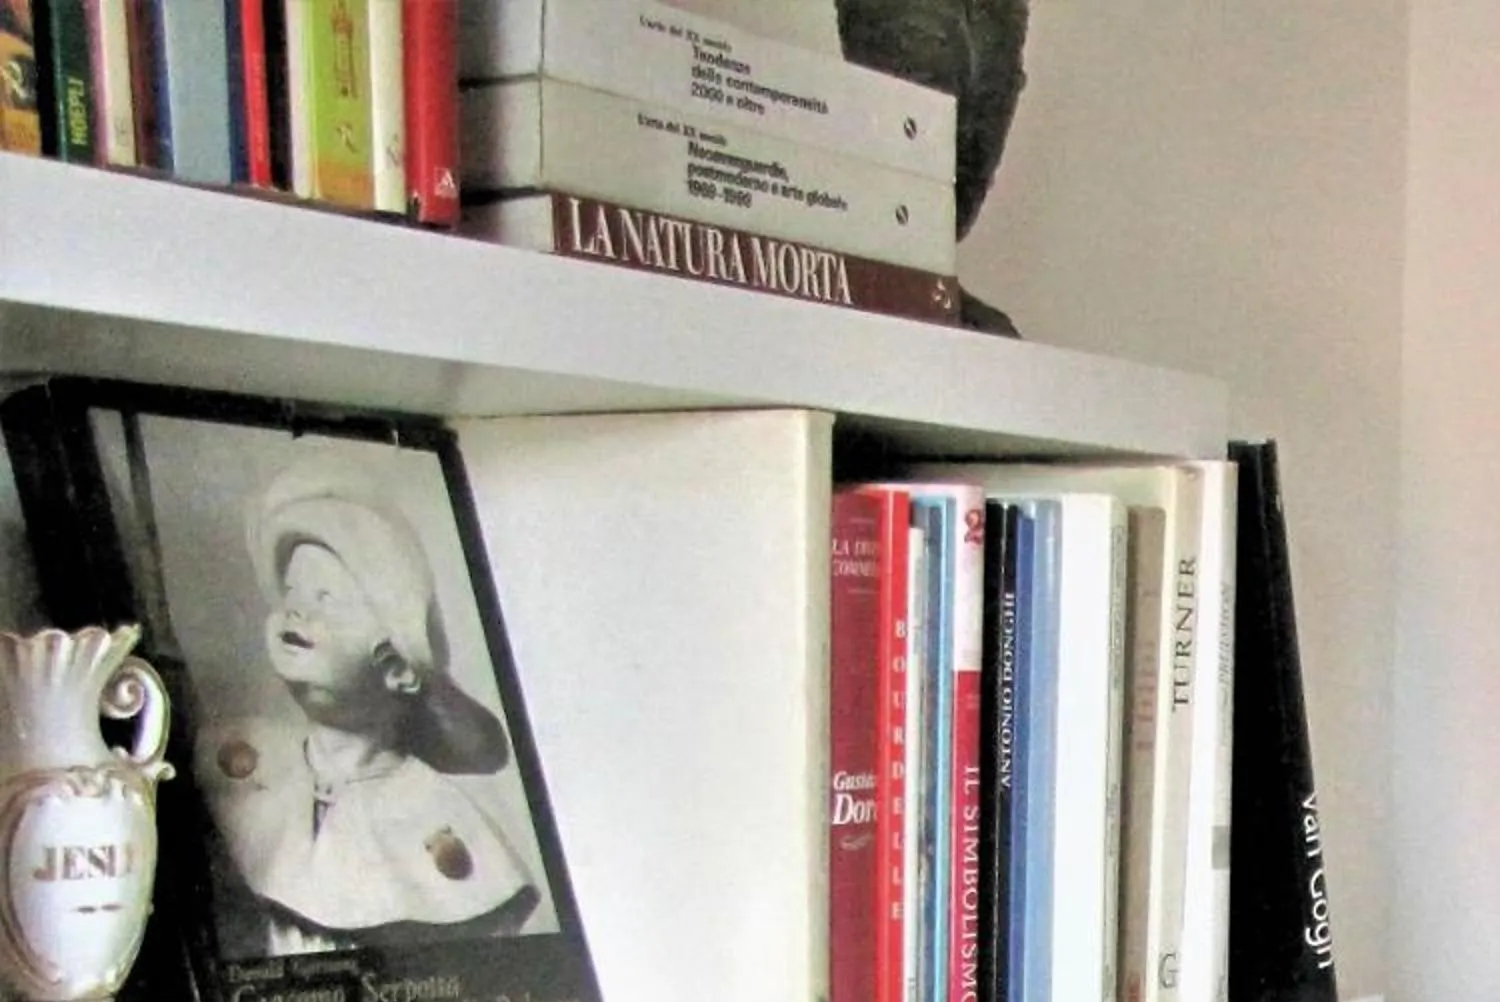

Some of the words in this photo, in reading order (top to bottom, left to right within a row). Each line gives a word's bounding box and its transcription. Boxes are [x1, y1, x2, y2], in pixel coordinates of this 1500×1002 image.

[568, 198, 614, 260] LA
[618, 207, 749, 285] NATURA
[750, 241, 852, 306] MORTA
[1000, 592, 1015, 683] DONGHI
[1172, 556, 1196, 713] TURNER
[1000, 686, 1015, 790] ANTONIO
